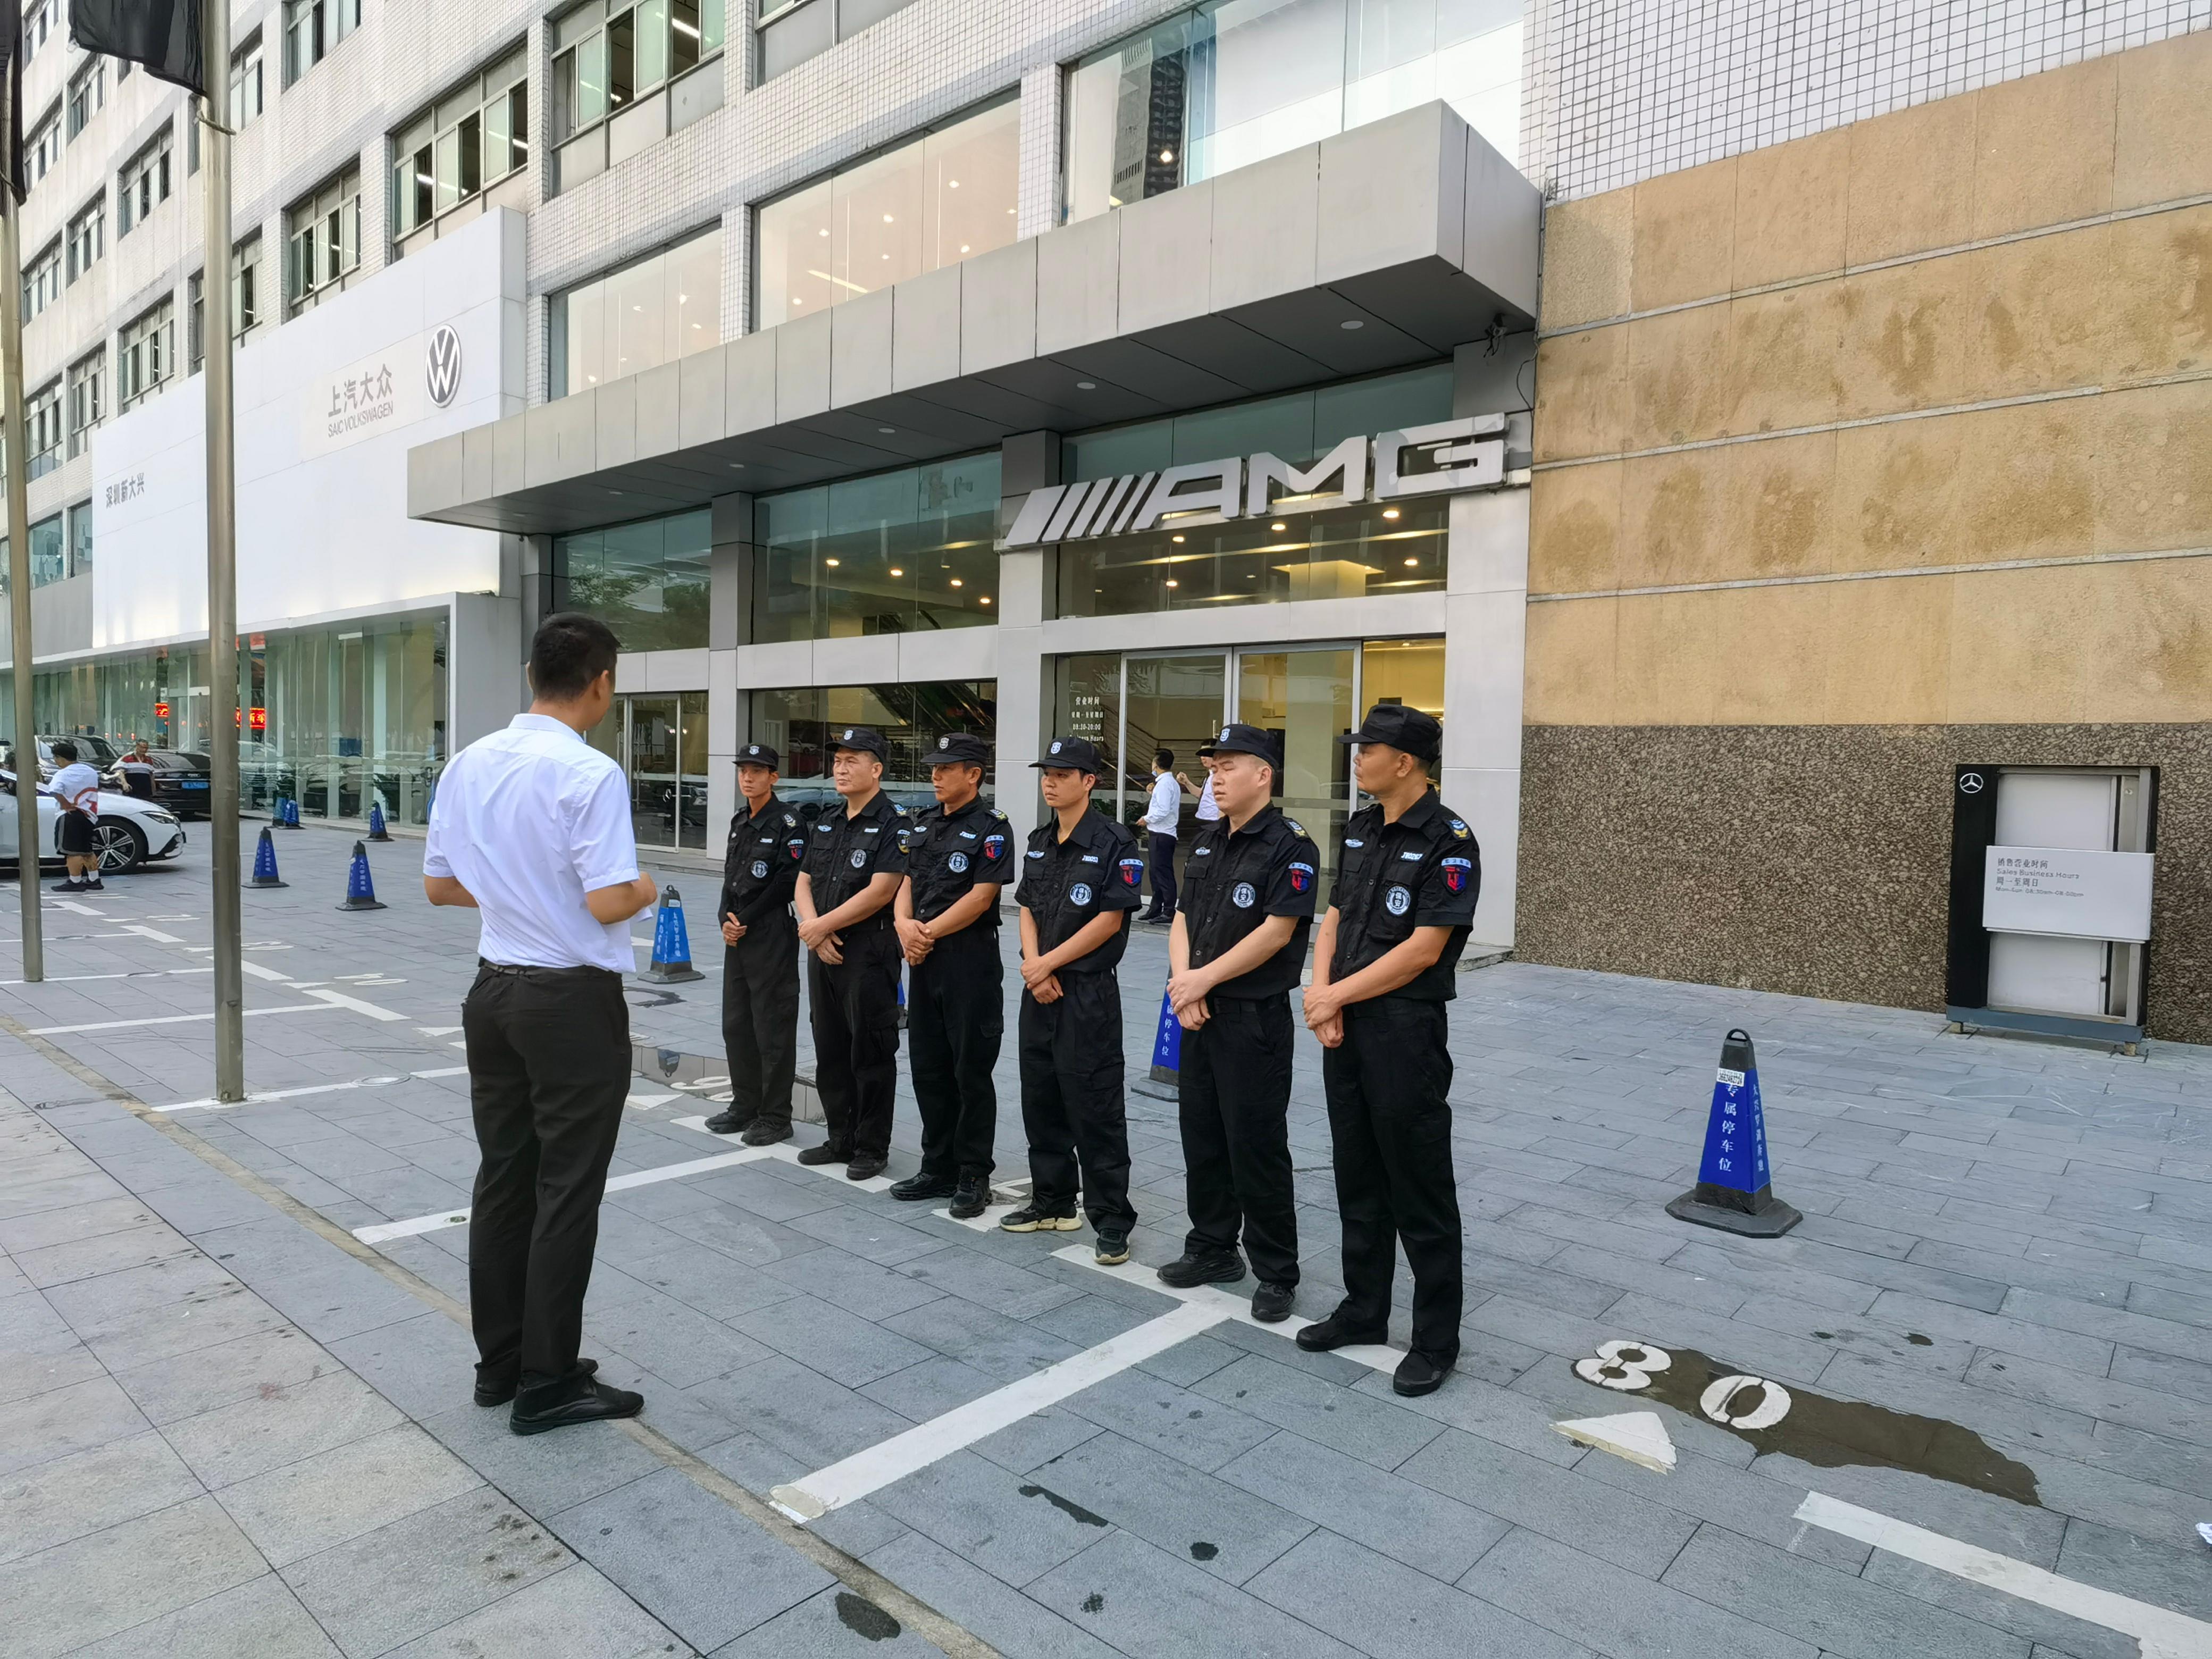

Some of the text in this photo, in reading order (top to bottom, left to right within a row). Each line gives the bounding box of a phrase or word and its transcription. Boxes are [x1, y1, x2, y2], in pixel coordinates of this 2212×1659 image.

[328, 363, 393, 417] 上汽大众
[328, 401, 393, 438] SAIC VOLKSWAGEN
[1132, 412, 1506, 531] AMG
[1075, 696, 1100, 706] 营业时间
[1996, 876, 2038, 887] 周一至周日
